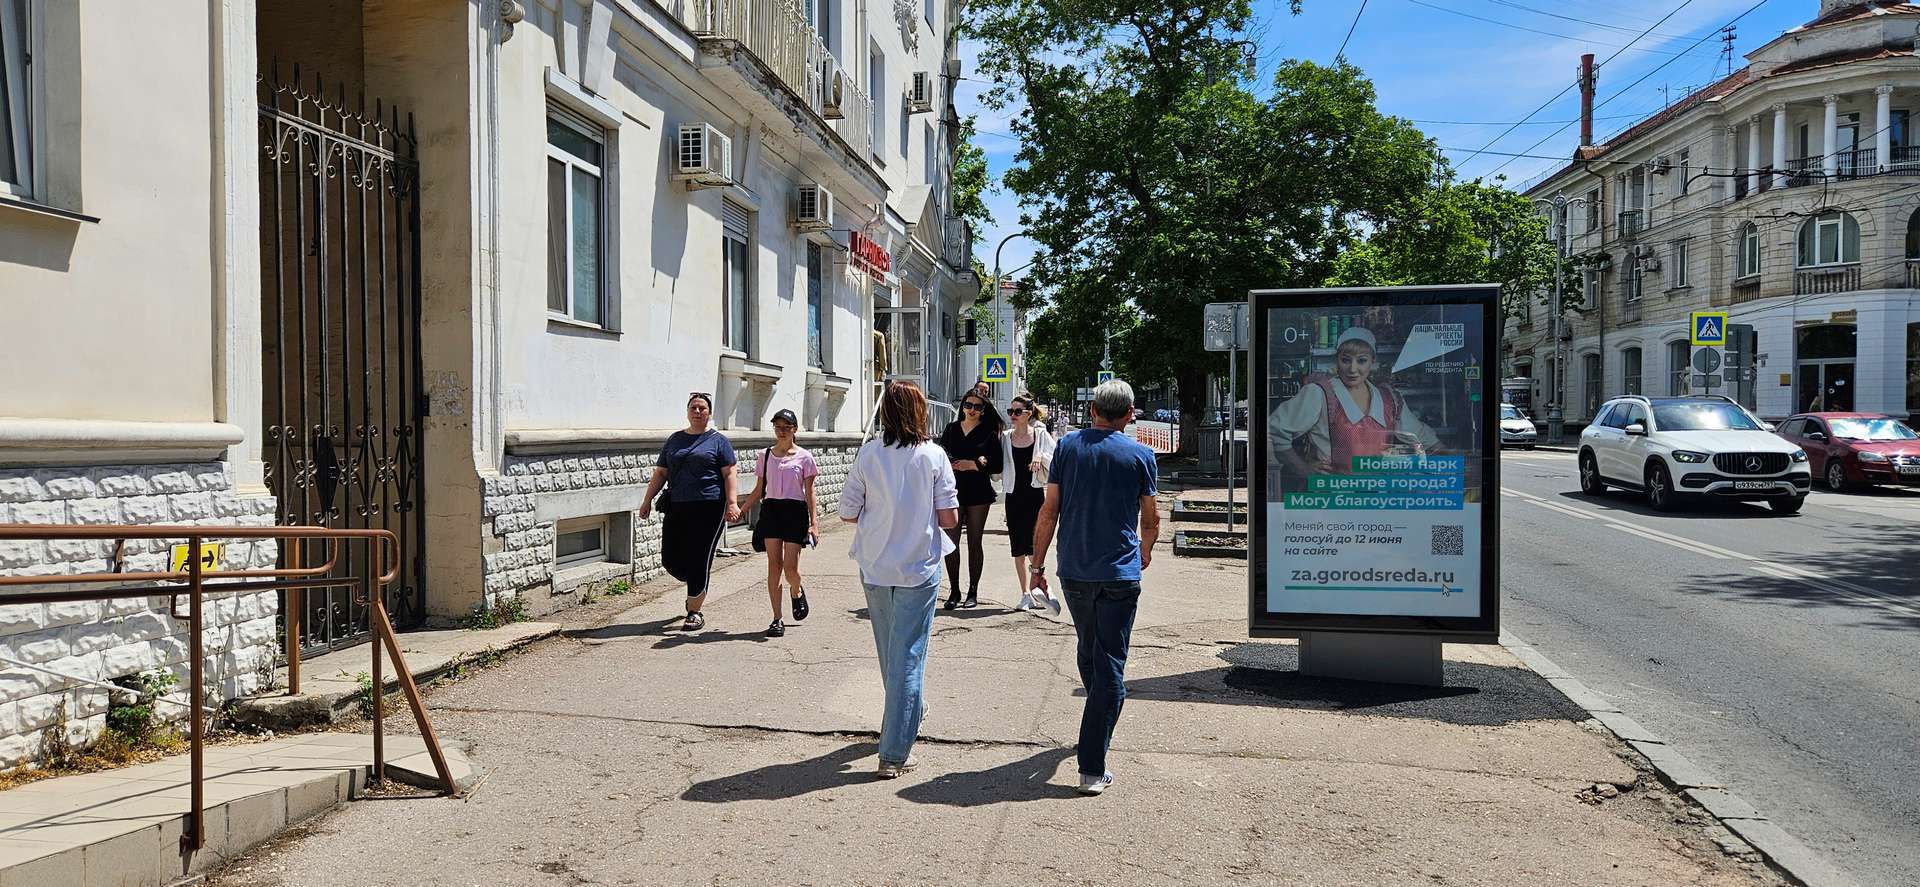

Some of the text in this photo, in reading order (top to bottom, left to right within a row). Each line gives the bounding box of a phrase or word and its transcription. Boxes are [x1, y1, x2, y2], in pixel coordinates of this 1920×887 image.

[1414, 325, 1464, 333] НАЦИОНАЛЬНЫЕ
[1284, 327, 1309, 343] 0+
[1434, 332, 1463, 340] ПРОЕКТЫ
[1439, 339, 1463, 347] РОССИИ
[1360, 456, 1457, 473] Новый парк
[1317, 477, 1457, 491] в центре города?
[1291, 494, 1457, 509] Могу благоустроить.
[1284, 522, 1324, 532] Меняй
[1326, 522, 1355, 532] свой
[1357, 523, 1393, 533] город
[1284, 534, 1402, 545] голосуй до 12 июня
[1284, 546, 1338, 556] на сайте
[1291, 567, 1455, 585] za.gorodsreda.ru
